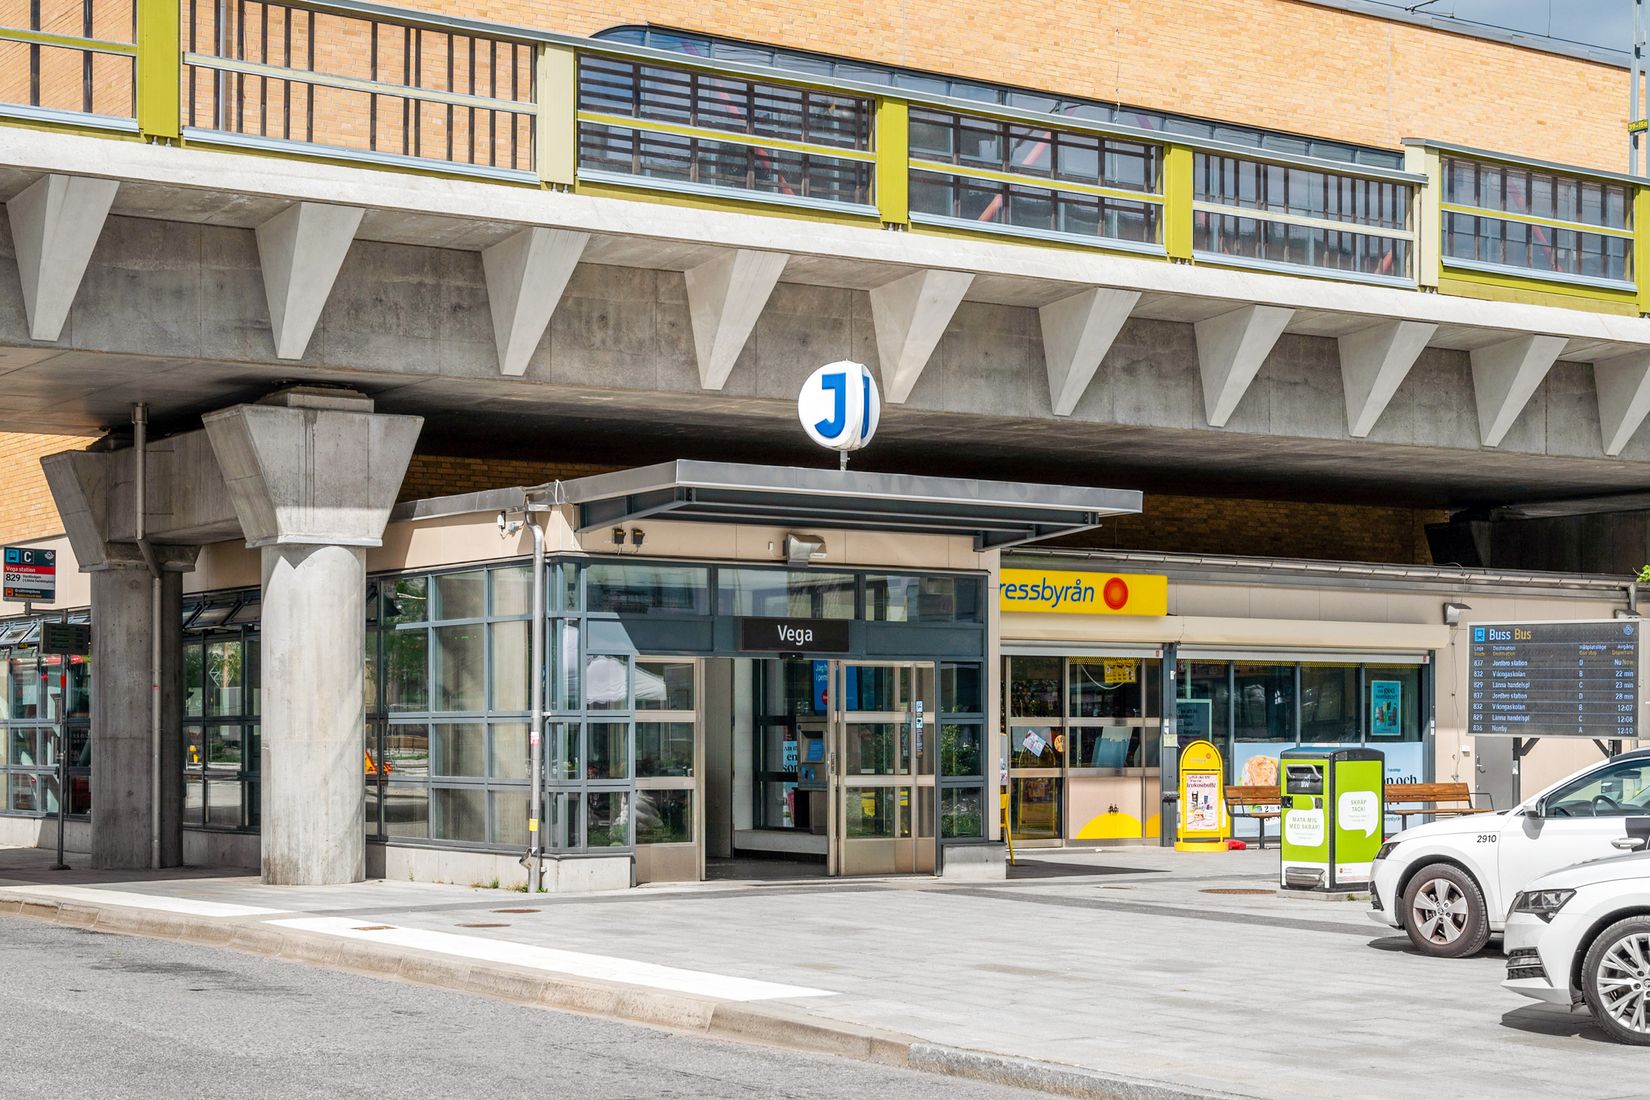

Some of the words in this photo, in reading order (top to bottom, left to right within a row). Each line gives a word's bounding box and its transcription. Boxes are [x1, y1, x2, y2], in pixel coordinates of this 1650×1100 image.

[814, 372, 846, 439] J
[24, 552, 32, 562] C
[6, 574, 20, 582] 829
[1000, 577, 1094, 607] ressbyrån
[777, 625, 813, 645] Vega
[1489, 629, 1511, 640] Buss
[1514, 628, 1532, 640] Bus
[1396, 774, 1416, 784] och
[1477, 834, 1496, 843] 2910
